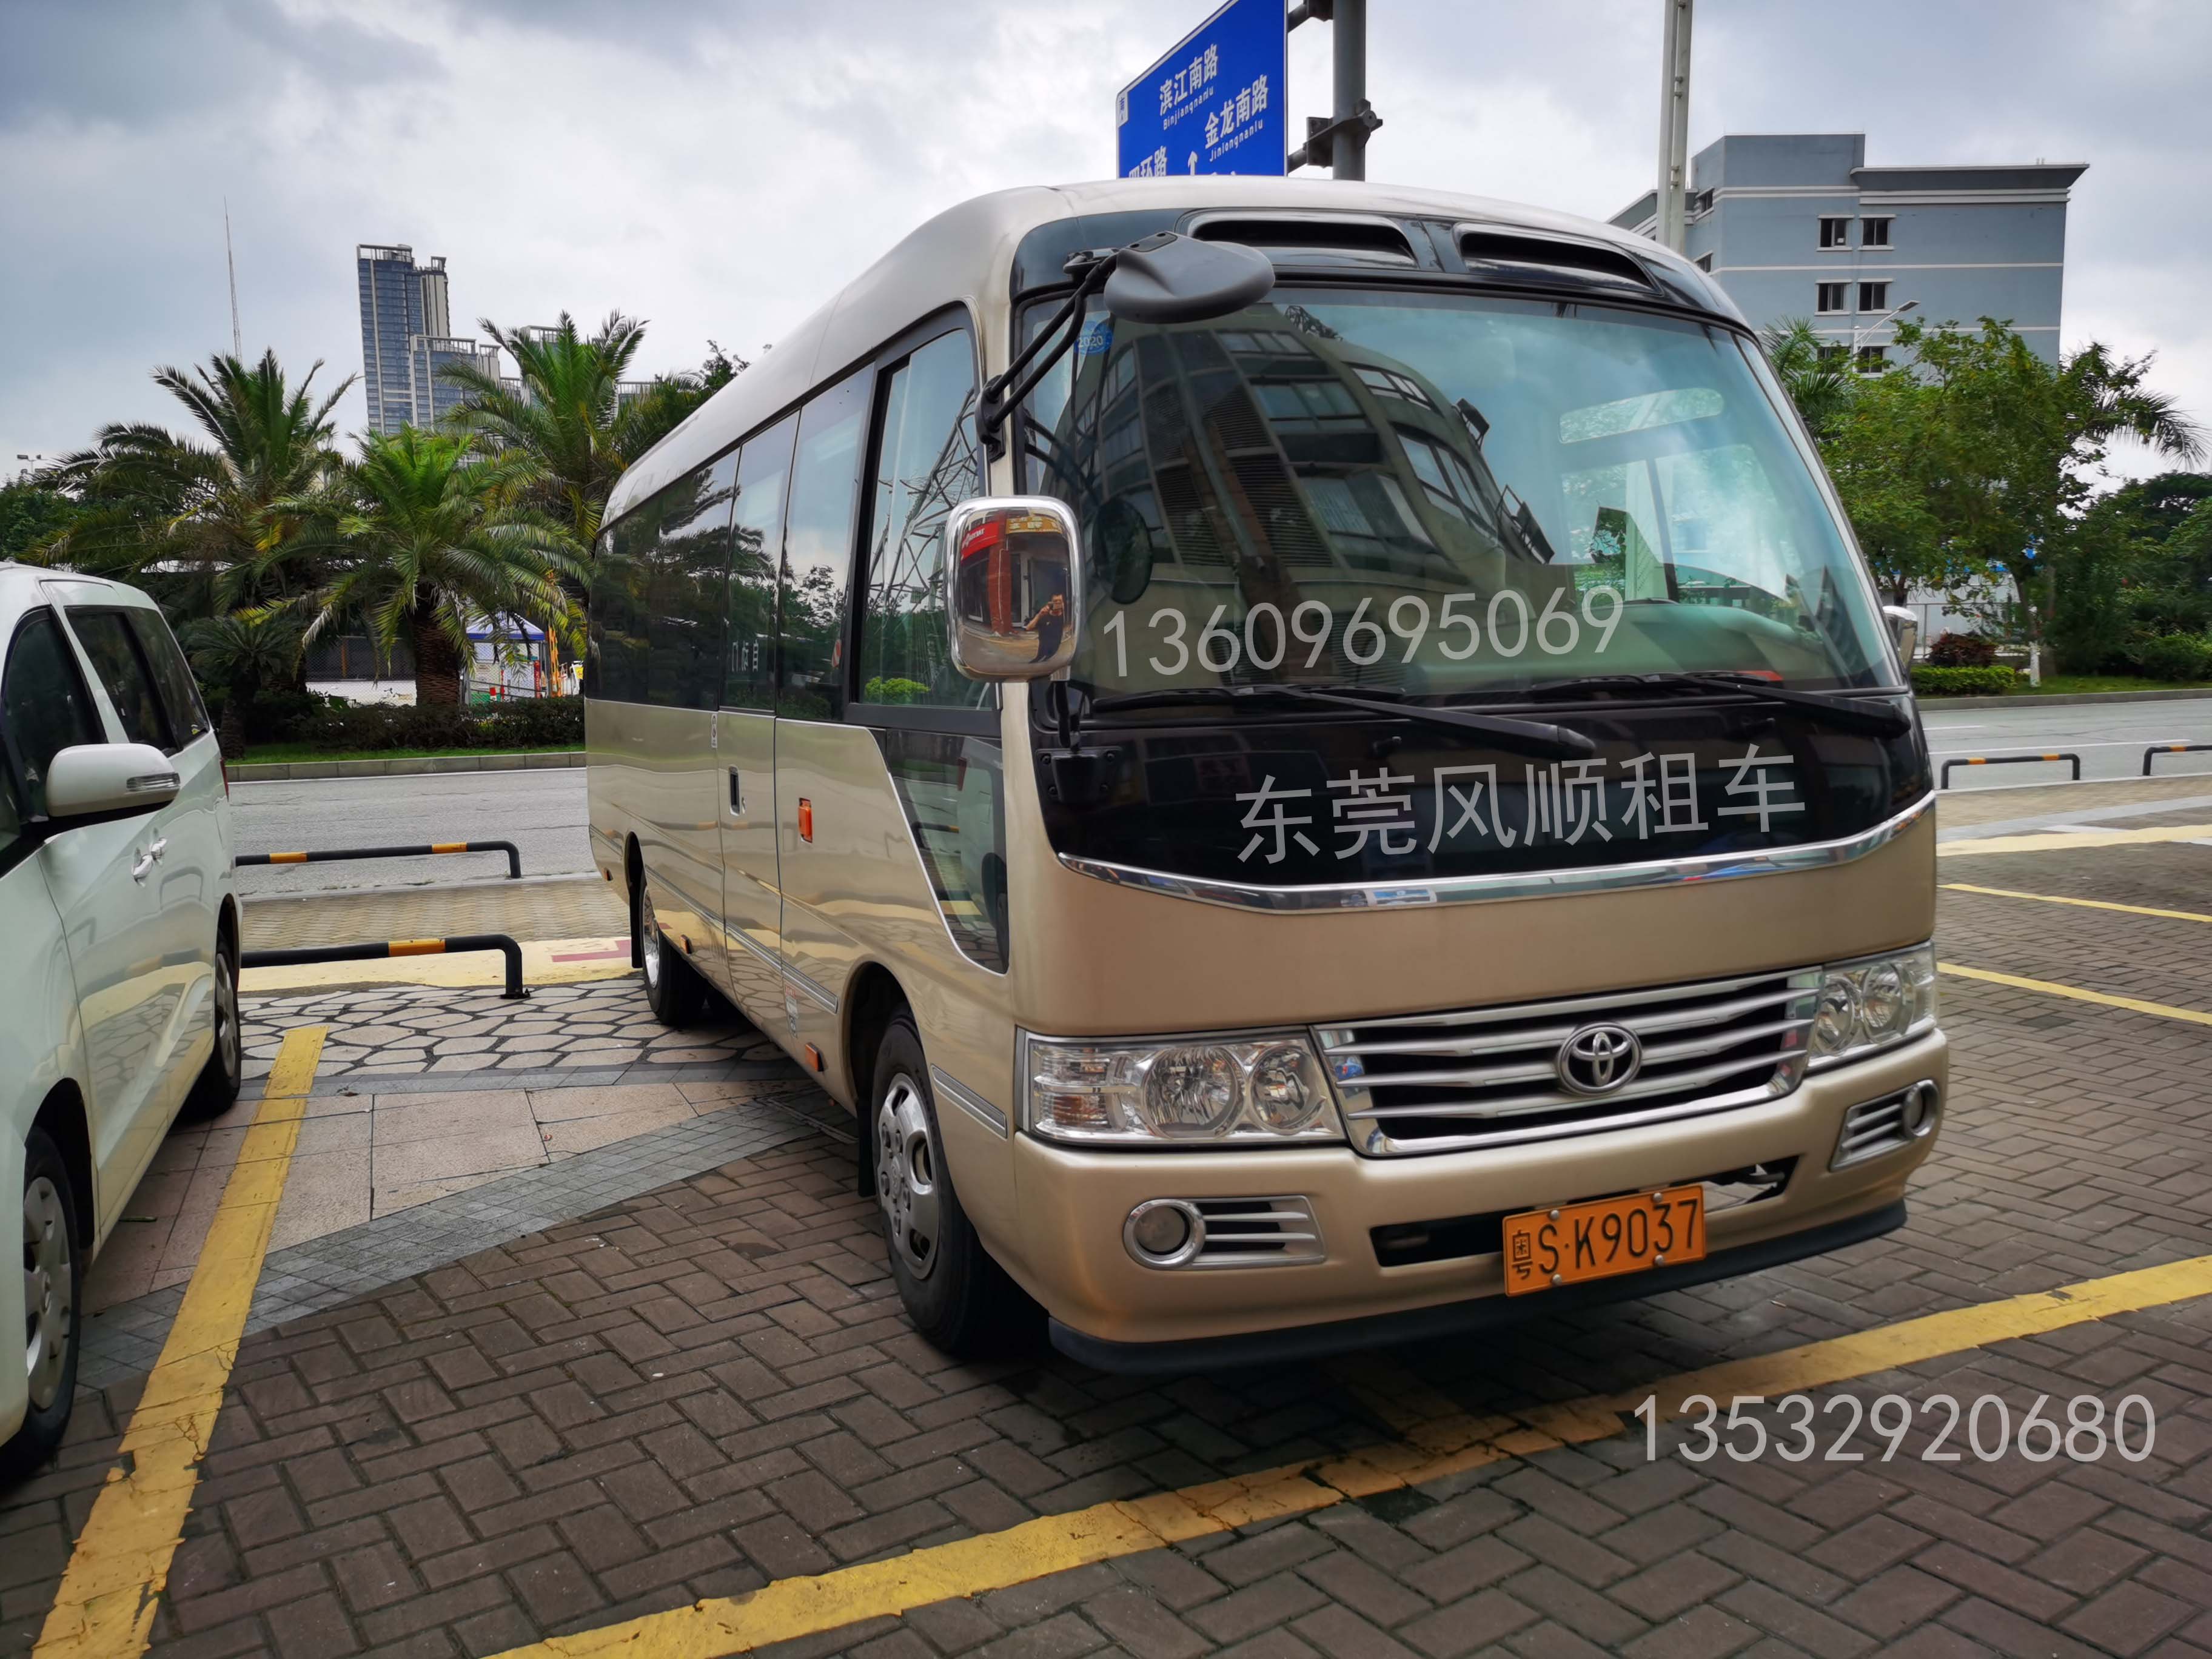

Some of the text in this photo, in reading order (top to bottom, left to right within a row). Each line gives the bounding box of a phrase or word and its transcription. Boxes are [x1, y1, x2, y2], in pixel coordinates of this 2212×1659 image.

[1160, 44, 1218, 116] 滨江南路
[1164, 86, 1214, 130] Binjiangnanlu
[1204, 74, 1269, 149] 金龙南路
[1209, 119, 1264, 162] Jinlongnanlu
